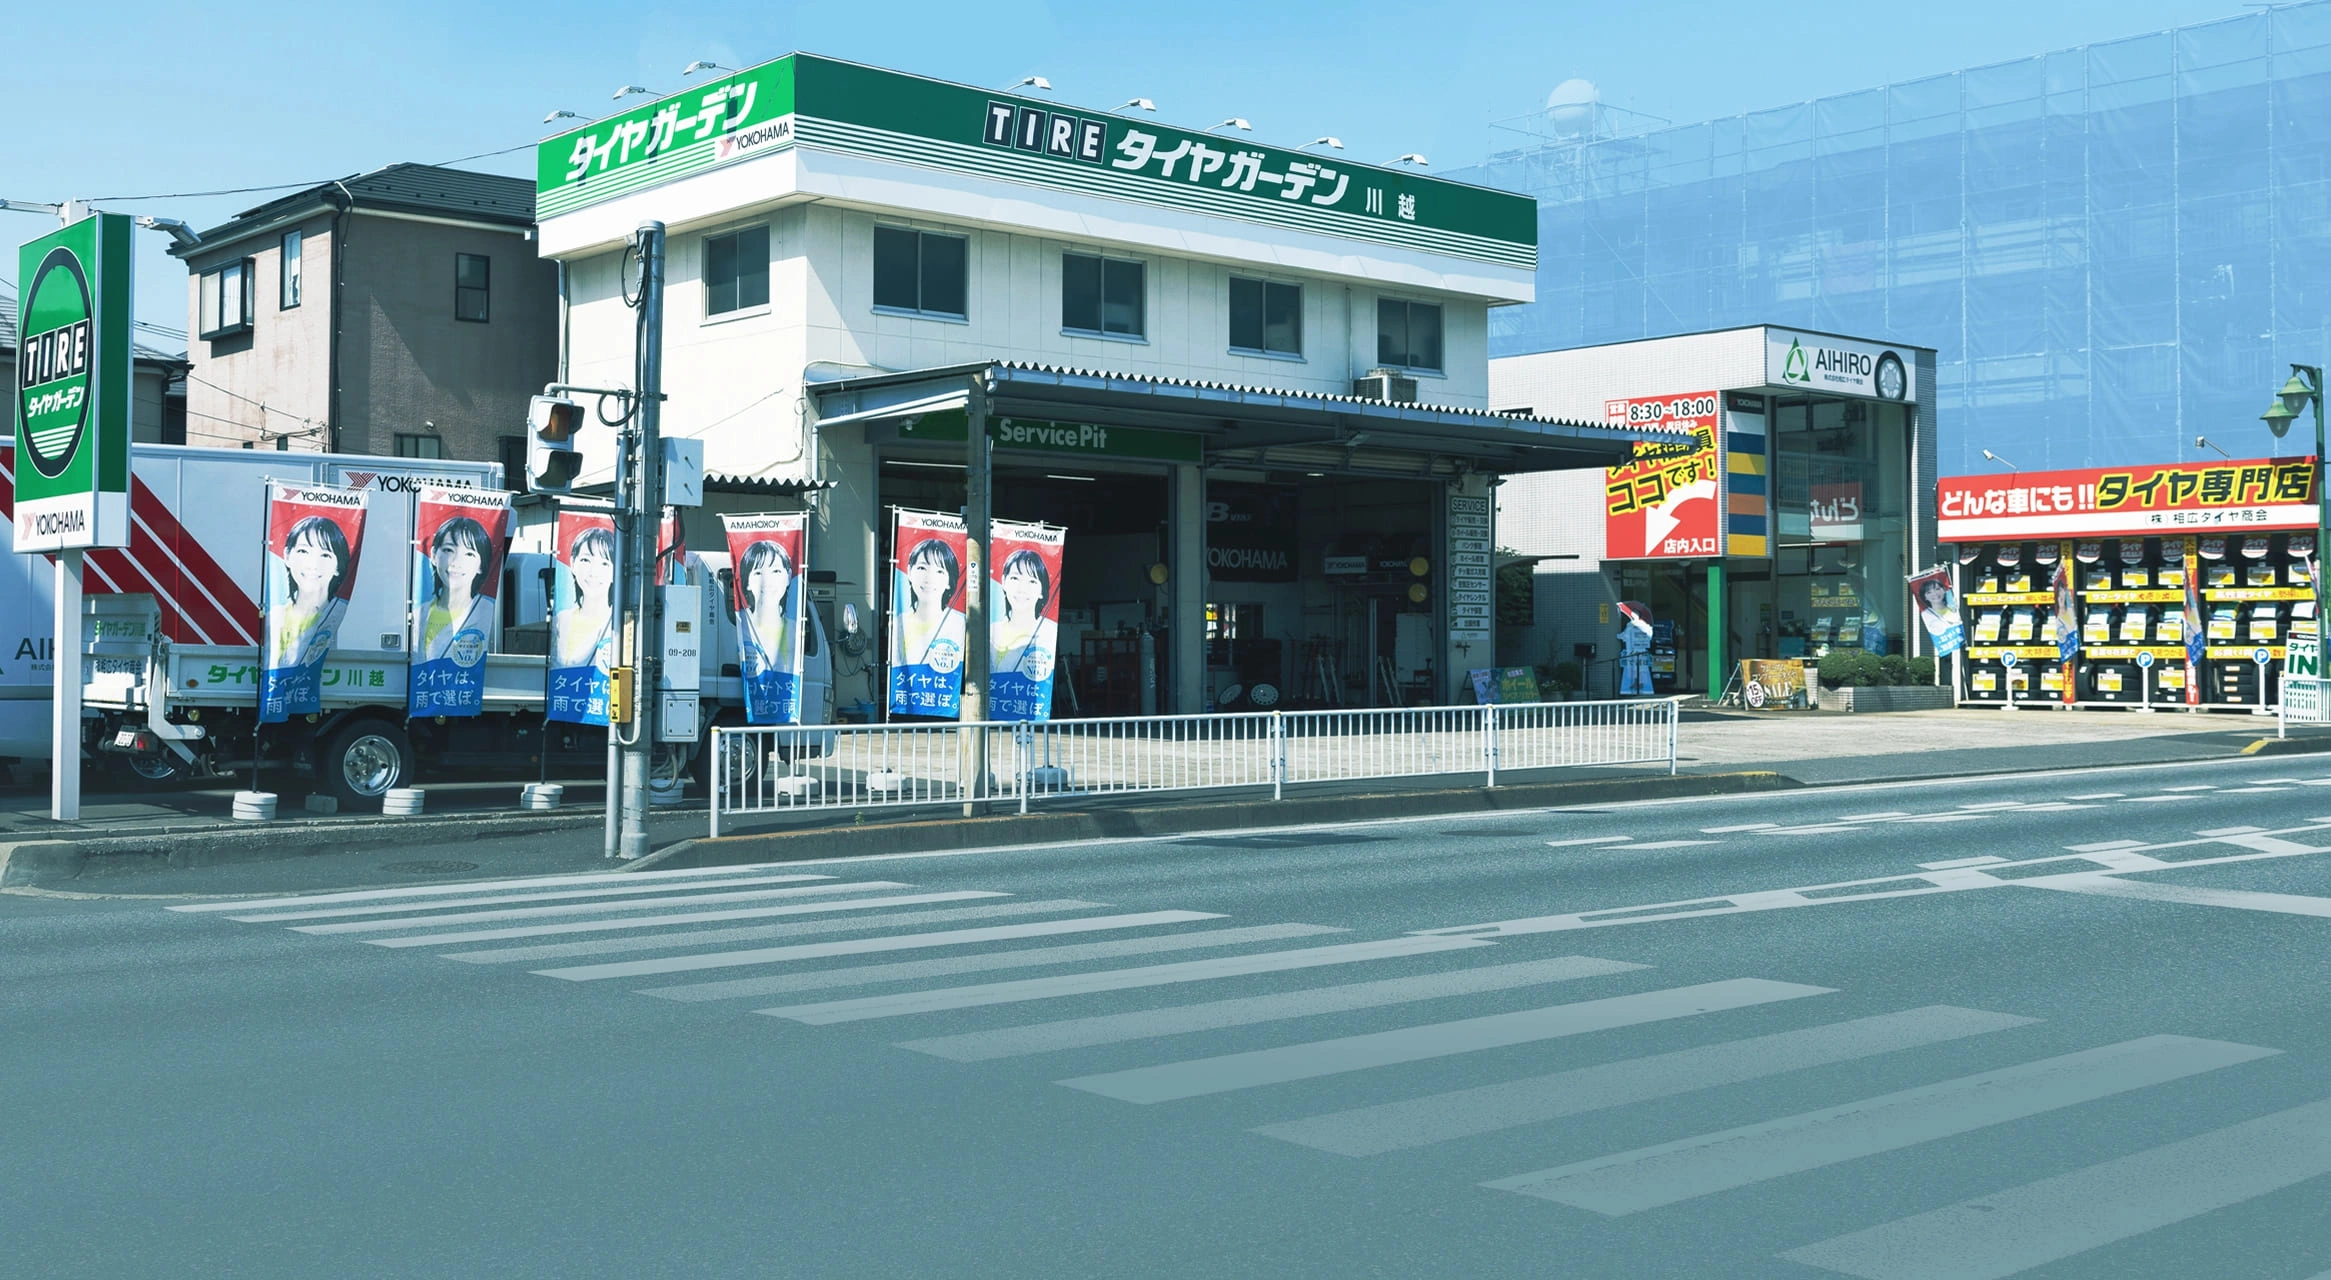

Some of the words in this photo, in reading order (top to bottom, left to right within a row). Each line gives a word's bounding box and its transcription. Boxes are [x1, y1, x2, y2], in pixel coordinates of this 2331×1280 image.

[565, 81, 758, 182] タイヤガーデン
[736, 121, 790, 150] YOKOHAMA
[992, 105, 1101, 159] TIRE
[1111, 129, 1350, 207] タイヤガーデン
[1365, 187, 1416, 220] 川越
[27, 326, 86, 382] TIRE
[1815, 348, 1872, 376] AIHIRO
[27, 386, 85, 418] タイヤガーデン
[1000, 418, 1077, 446] Service
[1080, 425, 1107, 448] Pit
[1608, 458, 1716, 513] ココです!
[1941, 485, 2095, 517] どんな車にも!!
[2095, 464, 2315, 508] タイヤ専門店
[301, 491, 361, 506] YOKOHAMA
[448, 492, 504, 507] YOKOHAMA
[1453, 499, 1486, 512] SERVICE
[36, 509, 86, 536] YOKOHAMA
[920, 518, 968, 531] YOKOHAMA
[1014, 529, 1058, 542] YOKOHAMA
[1664, 538, 1715, 553] 店内入口
[1207, 547, 1288, 569] OKOHAMA
[669, 648, 697, 658] 09-208
[347, 669, 385, 687] 川越
[417, 669, 475, 687] タイヤは、
[896, 672, 954, 690] タイヤは、
